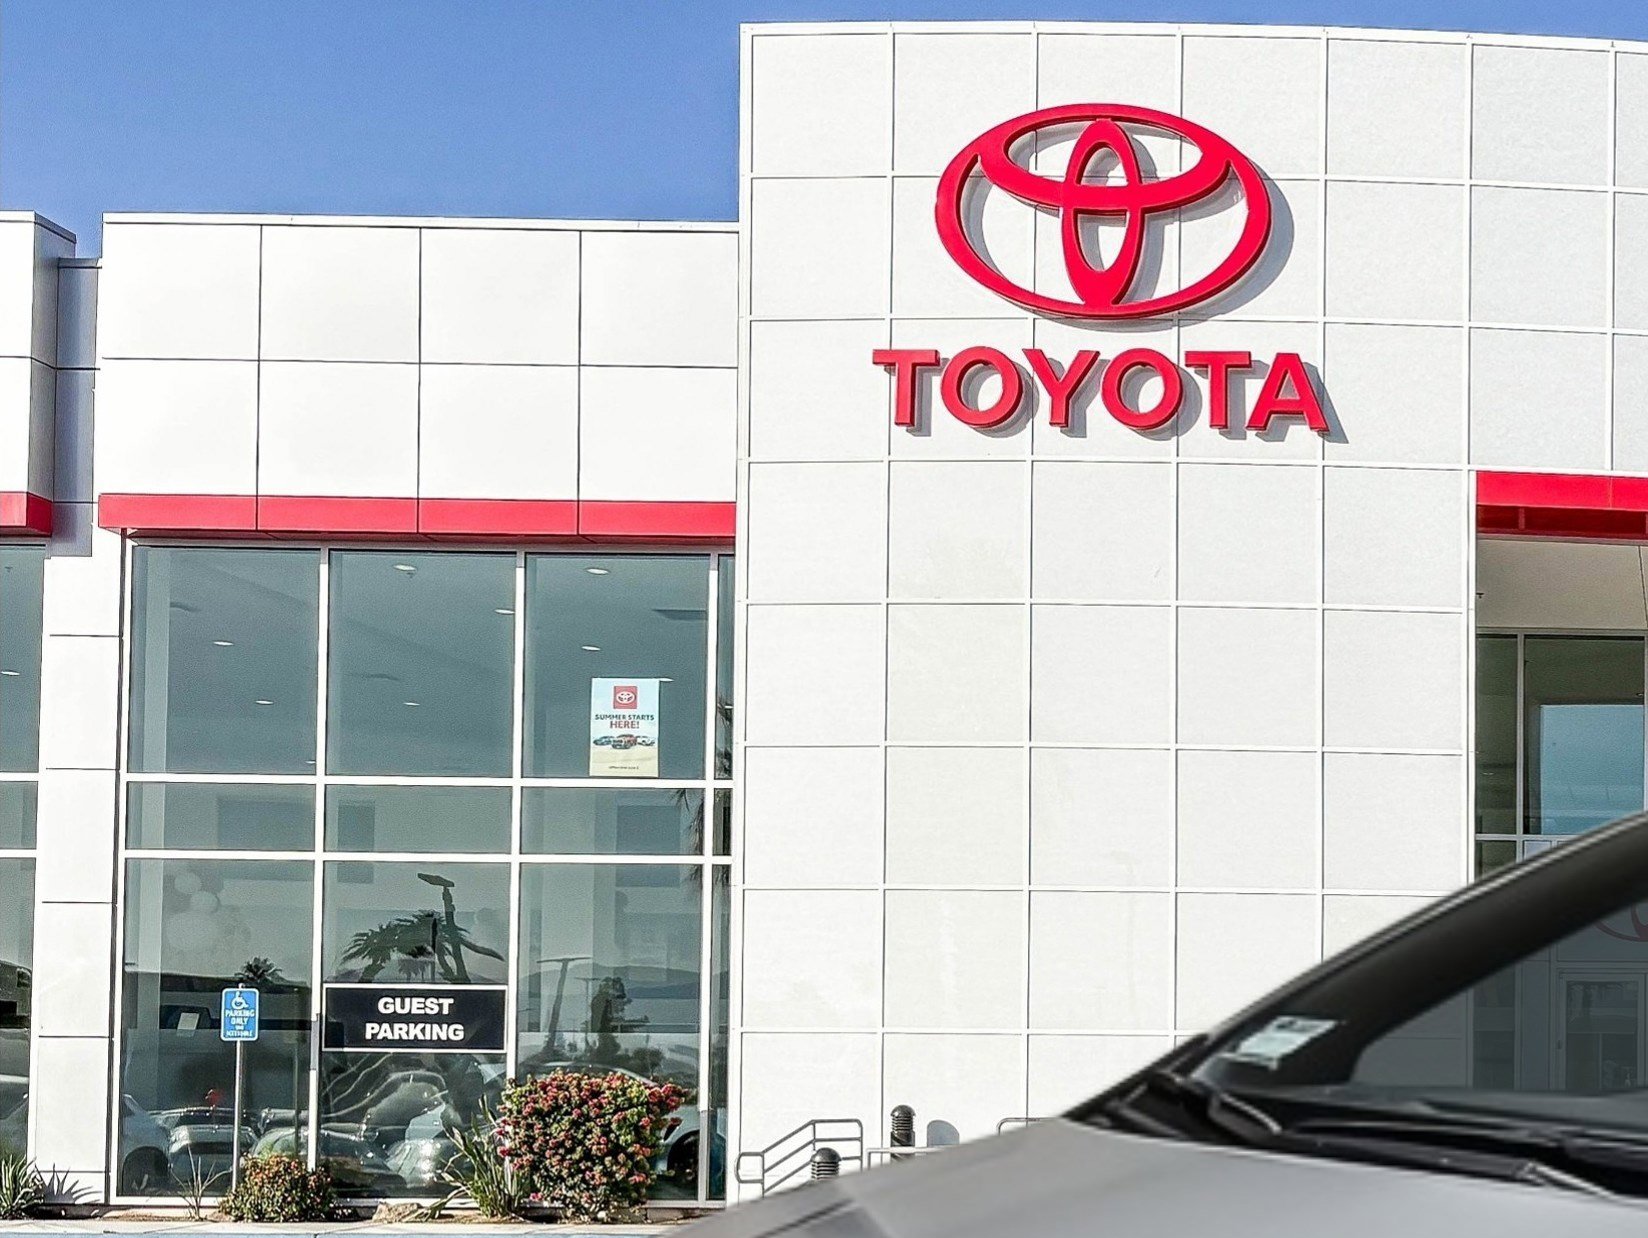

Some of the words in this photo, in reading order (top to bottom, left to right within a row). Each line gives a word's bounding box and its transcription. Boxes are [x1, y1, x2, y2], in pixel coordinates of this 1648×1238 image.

[872, 345, 1332, 433] TOYOTA
[609, 720, 640, 729] HERE!
[377, 996, 454, 1015] GUEST
[225, 1009, 255, 1018] PARKING
[230, 1016, 249, 1025] ONLY
[365, 1022, 465, 1041] PARKING
